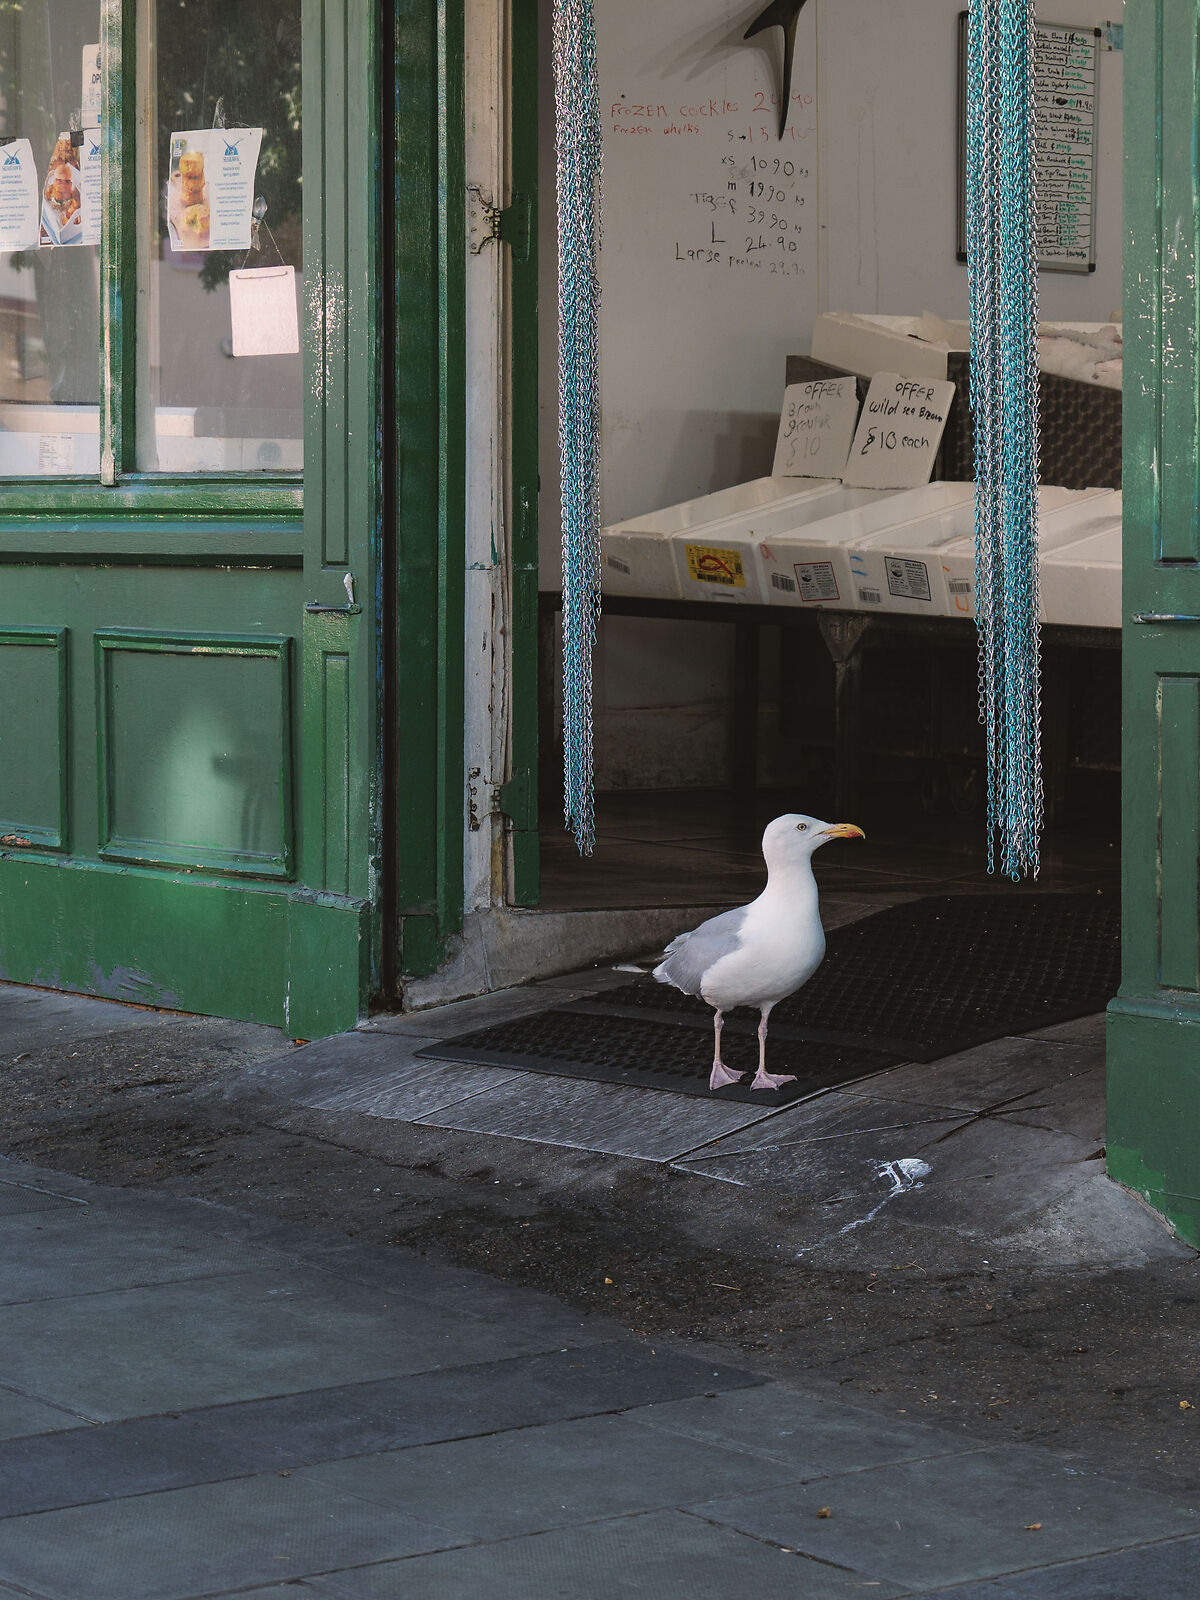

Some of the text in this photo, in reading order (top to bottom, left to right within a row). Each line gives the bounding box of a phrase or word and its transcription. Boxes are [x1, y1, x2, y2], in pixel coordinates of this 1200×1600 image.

[92, 73, 101, 84] OP
[711, 221, 727, 243] L
[676, 242, 720, 263] Large
[804, 381, 845, 400] OFFER
[895, 382, 935, 401] OFFER
[901, 434, 930, 449] each
